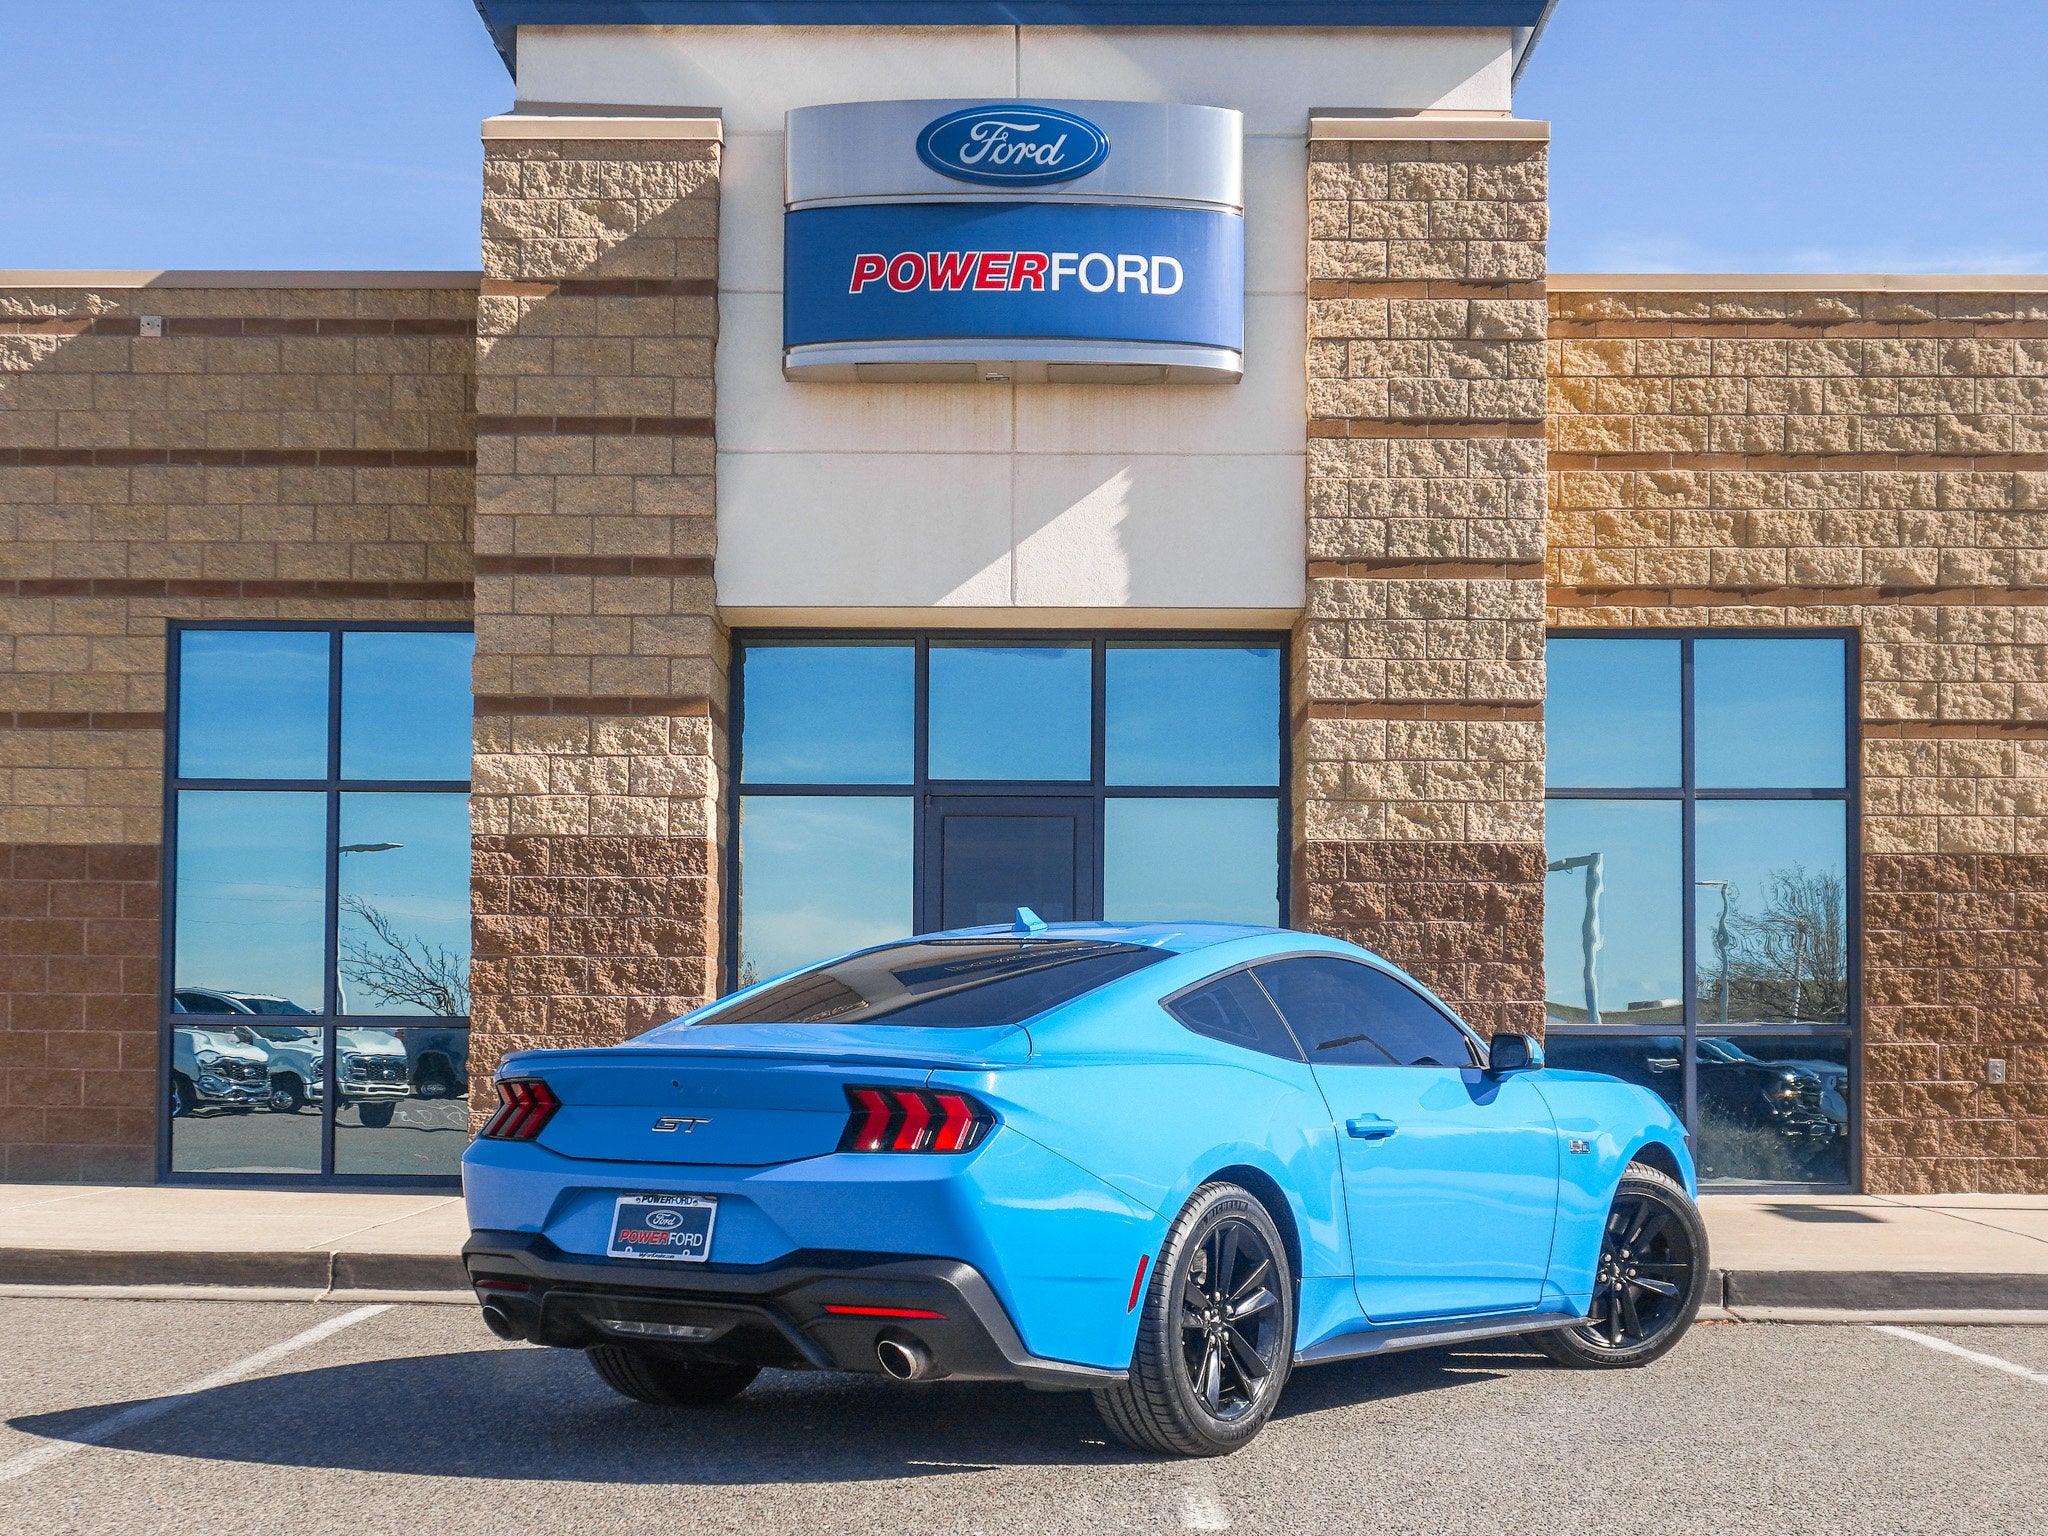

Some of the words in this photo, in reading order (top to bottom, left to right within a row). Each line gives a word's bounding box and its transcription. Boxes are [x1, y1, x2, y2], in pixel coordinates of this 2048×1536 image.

[959, 121, 1067, 166] Ford
[651, 1116, 713, 1133] GT
[652, 1213, 676, 1226] Ford
